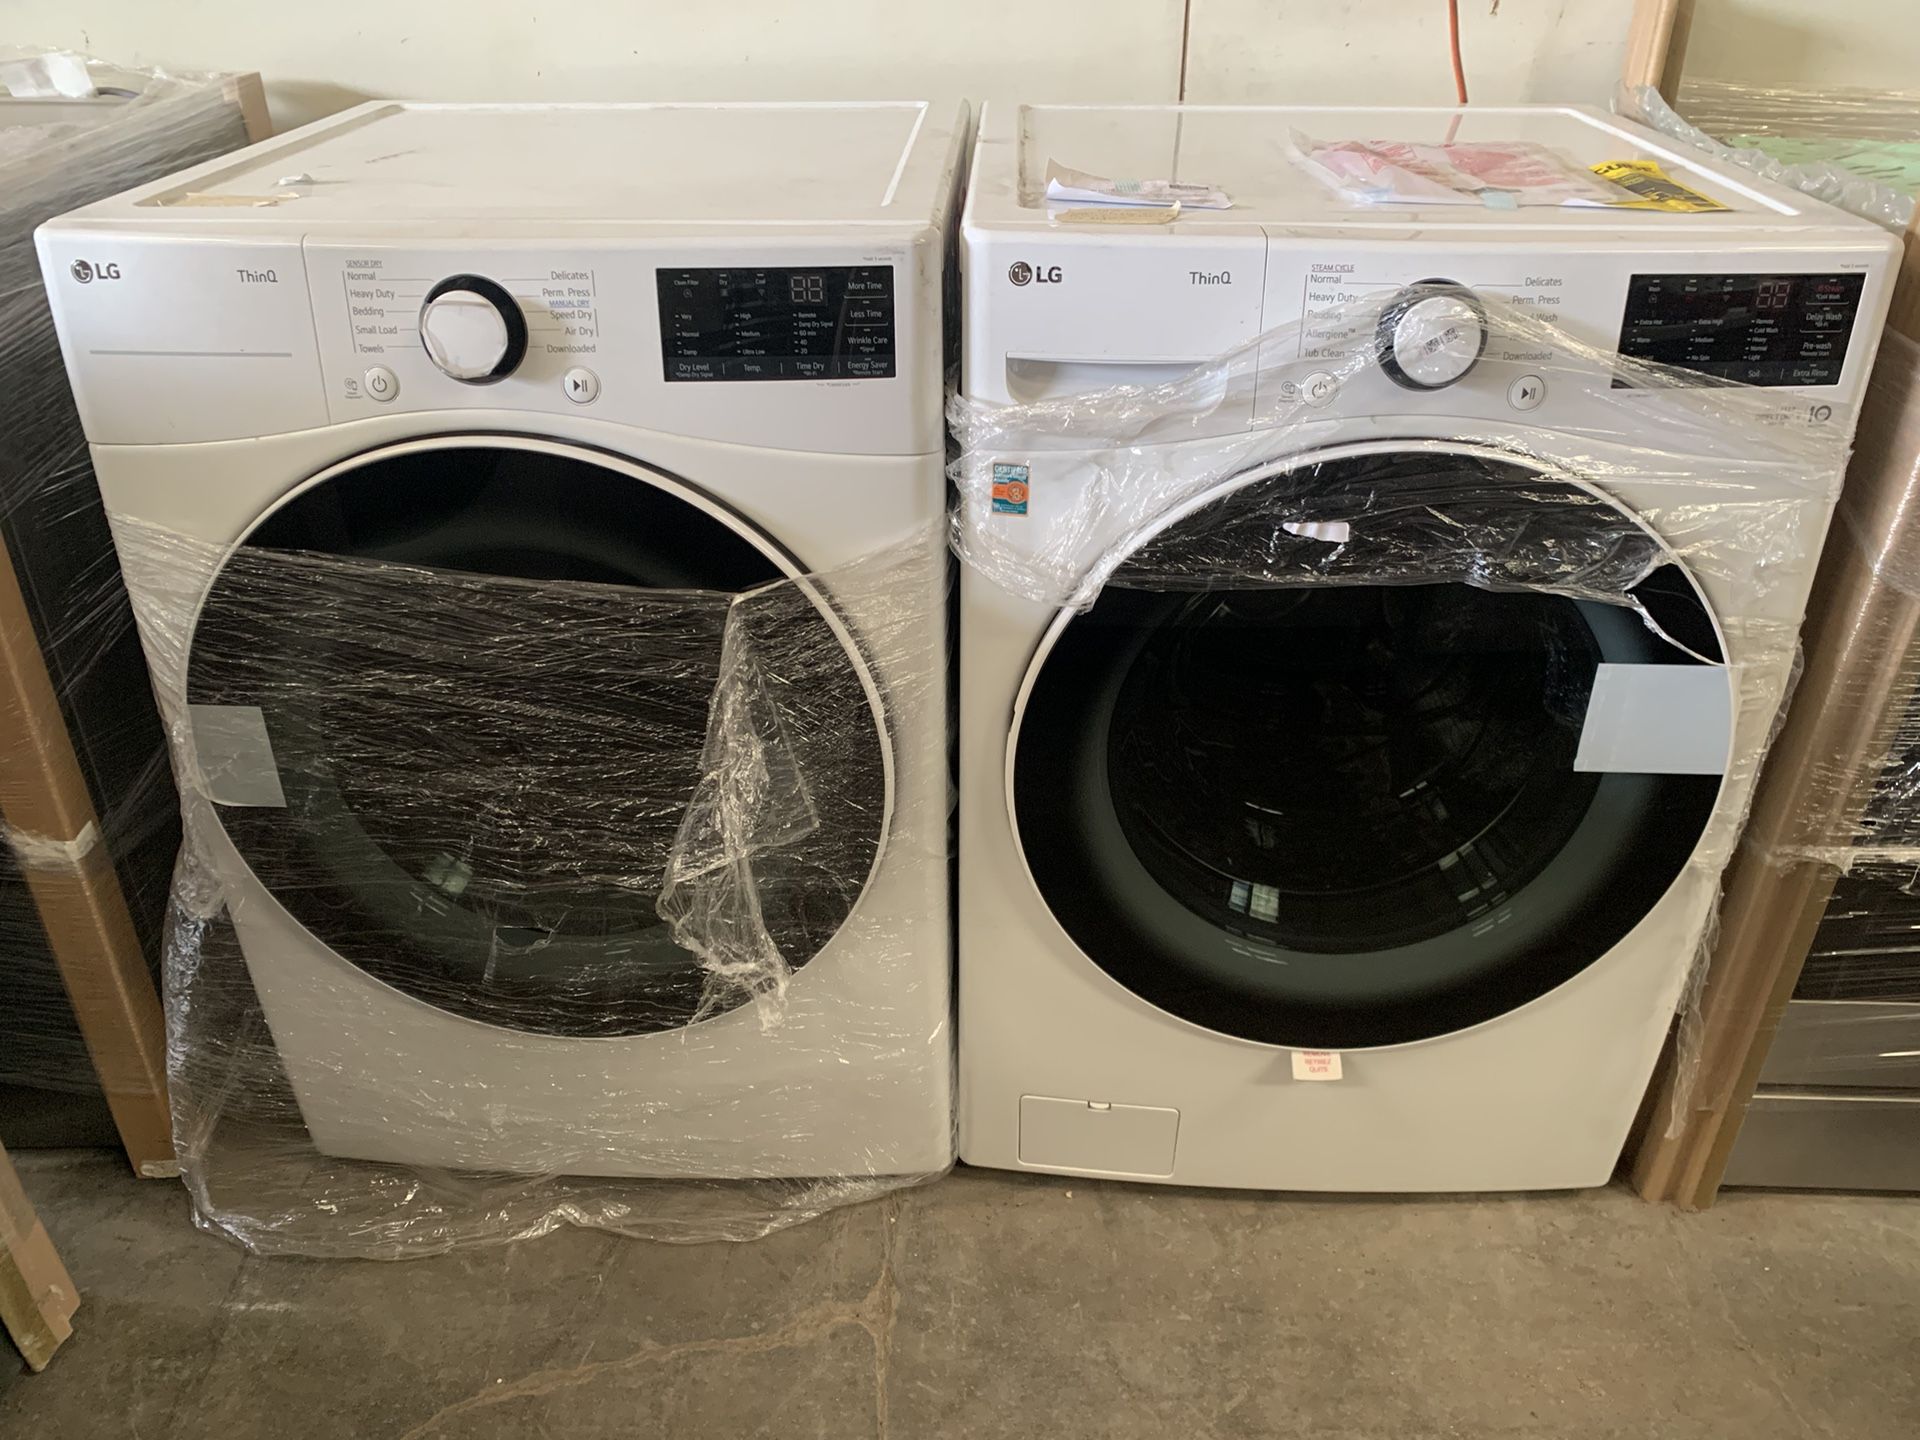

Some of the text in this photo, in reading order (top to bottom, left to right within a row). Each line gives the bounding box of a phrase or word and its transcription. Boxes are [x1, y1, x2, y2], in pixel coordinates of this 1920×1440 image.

[346, 260, 383, 268] SENSOR DRY
[96, 263, 121, 280] LG
[236, 269, 278, 283] ThinQ
[551, 271, 589, 280] Delicates
[1036, 266, 1062, 283] LG
[347, 272, 376, 281] Normal
[1189, 271, 1232, 285] ThinQ
[1310, 274, 1341, 283] Normal
[848, 282, 882, 290] More Time
[1525, 277, 1562, 287] Delicates
[350, 289, 395, 299] Heavy Duty
[542, 288, 590, 297] Perm. Press
[1309, 292, 1358, 304] Heavy Duty
[1512, 295, 1560, 304] Perm. Press
[353, 306, 384, 317] Bedding
[550, 310, 592, 320] Speed Dry
[850, 310, 882, 318] Less Time
[1536, 313, 1558, 322] Wash
[1806, 312, 1842, 321] Delay Wash
[355, 325, 397, 334] Small Load
[565, 327, 594, 337] Air Dry
[359, 344, 384, 353] Towels
[547, 344, 597, 353] Downloaded
[1803, 342, 1832, 350] Pre-wash
[1321, 348, 1345, 357] Clean
[1503, 352, 1552, 361] Downloaded
[680, 363, 709, 372] Dry Level
[813, 362, 824, 371] Dry
[847, 361, 869, 370] Energy
[1793, 369, 1828, 377] Extra Rinse
